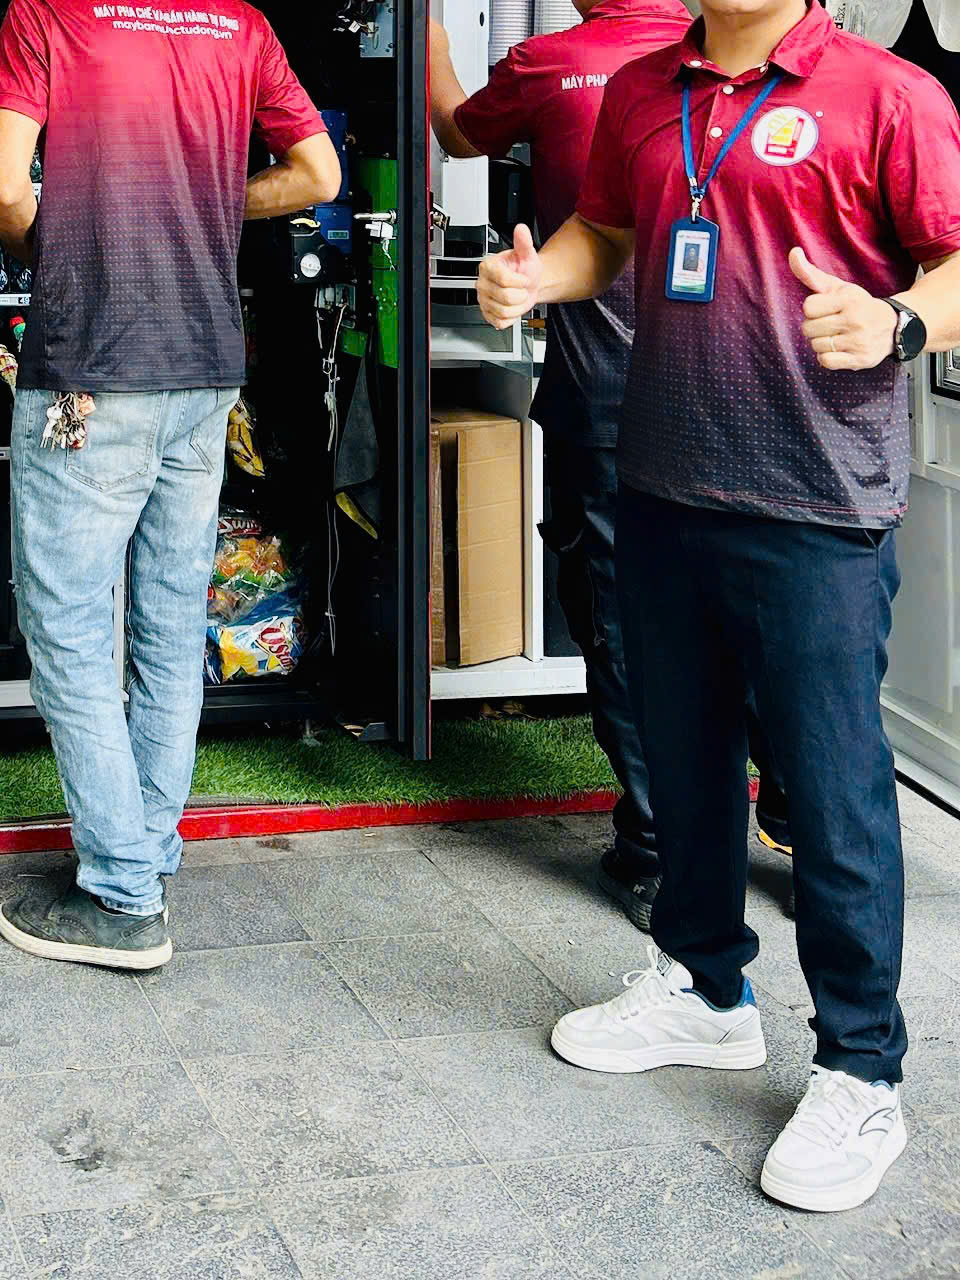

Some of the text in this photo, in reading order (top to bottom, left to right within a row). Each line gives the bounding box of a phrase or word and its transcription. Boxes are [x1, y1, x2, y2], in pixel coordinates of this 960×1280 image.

[93, 3, 115, 18] MÁY
[117, 5, 136, 18] PHA
[135, 6, 153, 20] CHẾ
[561, 74, 584, 90] MÁY
